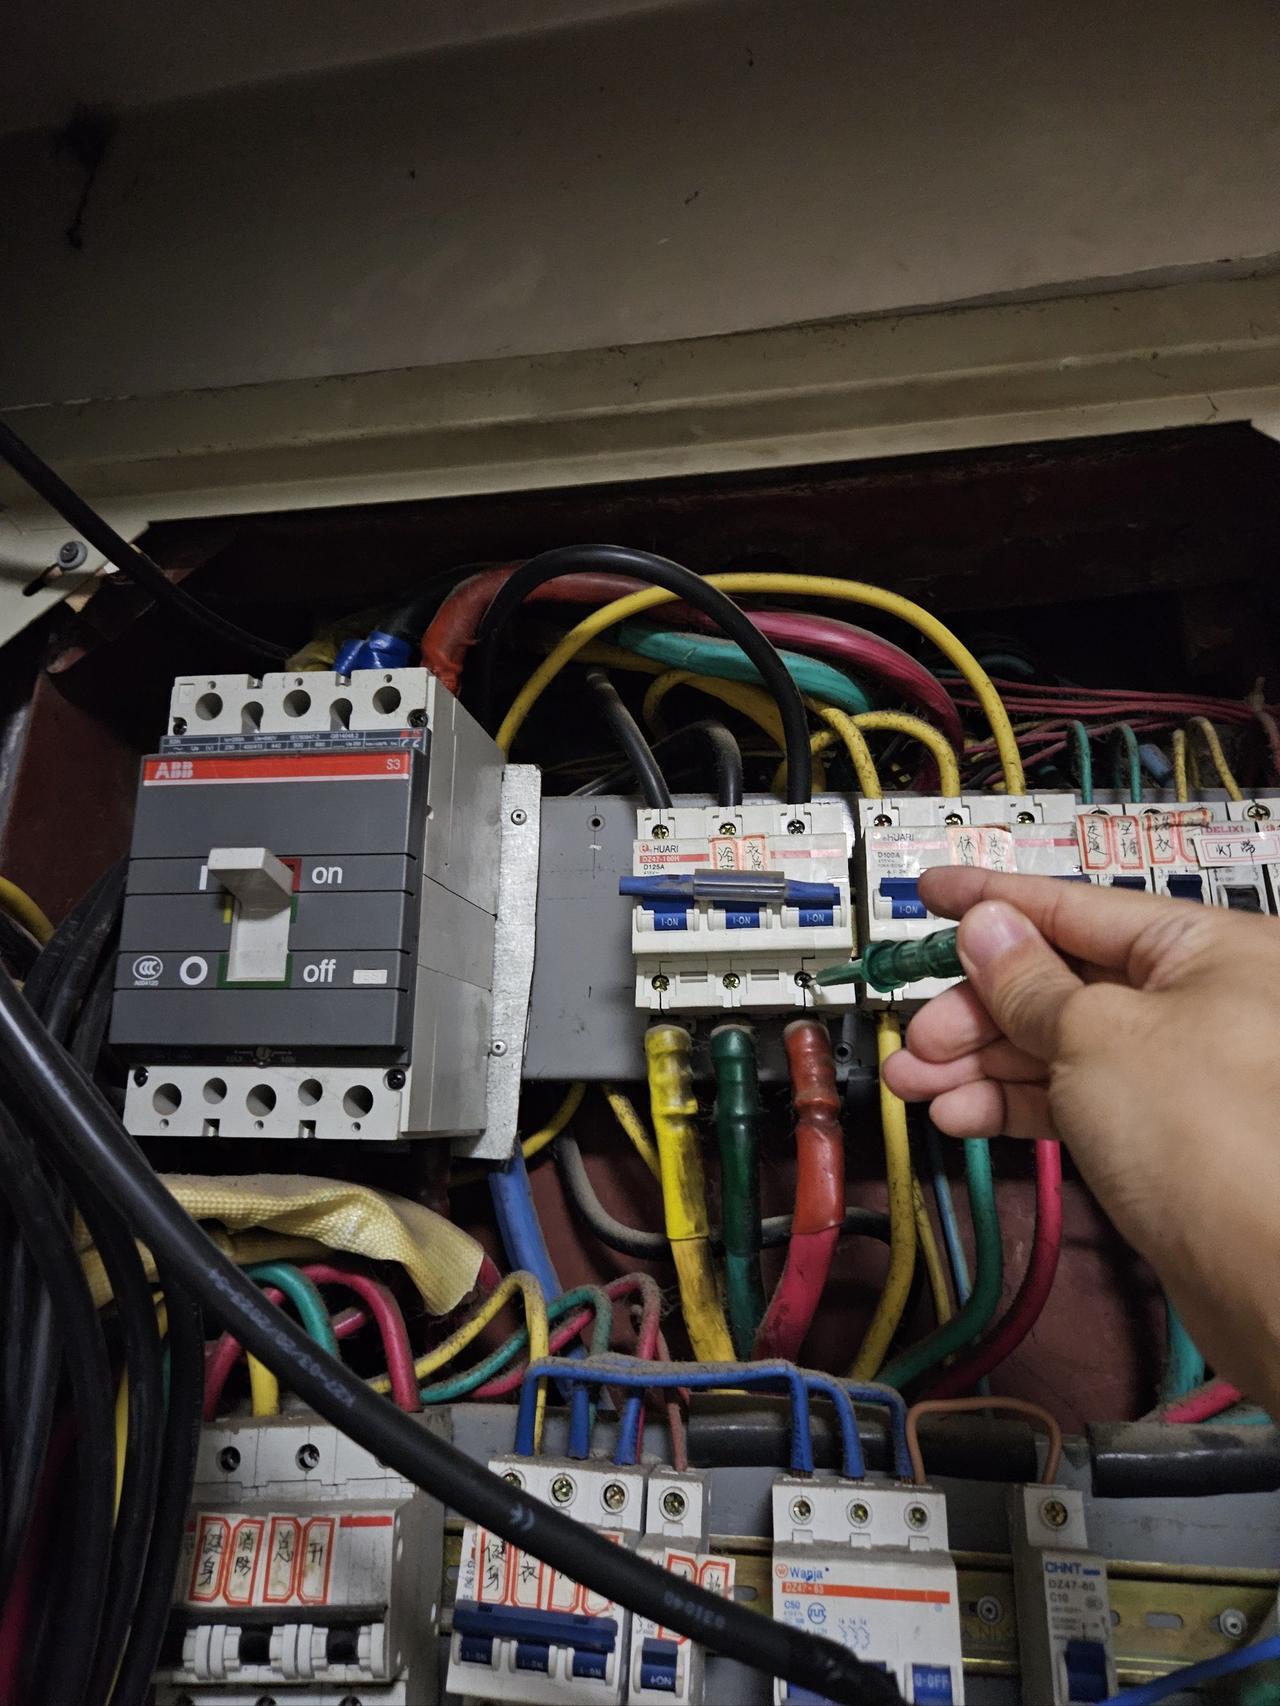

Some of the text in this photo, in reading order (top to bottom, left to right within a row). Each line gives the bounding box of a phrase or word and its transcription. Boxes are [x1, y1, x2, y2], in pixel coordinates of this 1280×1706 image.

[154, 761, 194, 779] ABB
[386, 758, 401, 770] S3
[653, 845, 680, 854] HUARI
[311, 866, 344, 885] on
[303, 959, 337, 983] off
[1045, 1561, 1081, 1574] CHNT
